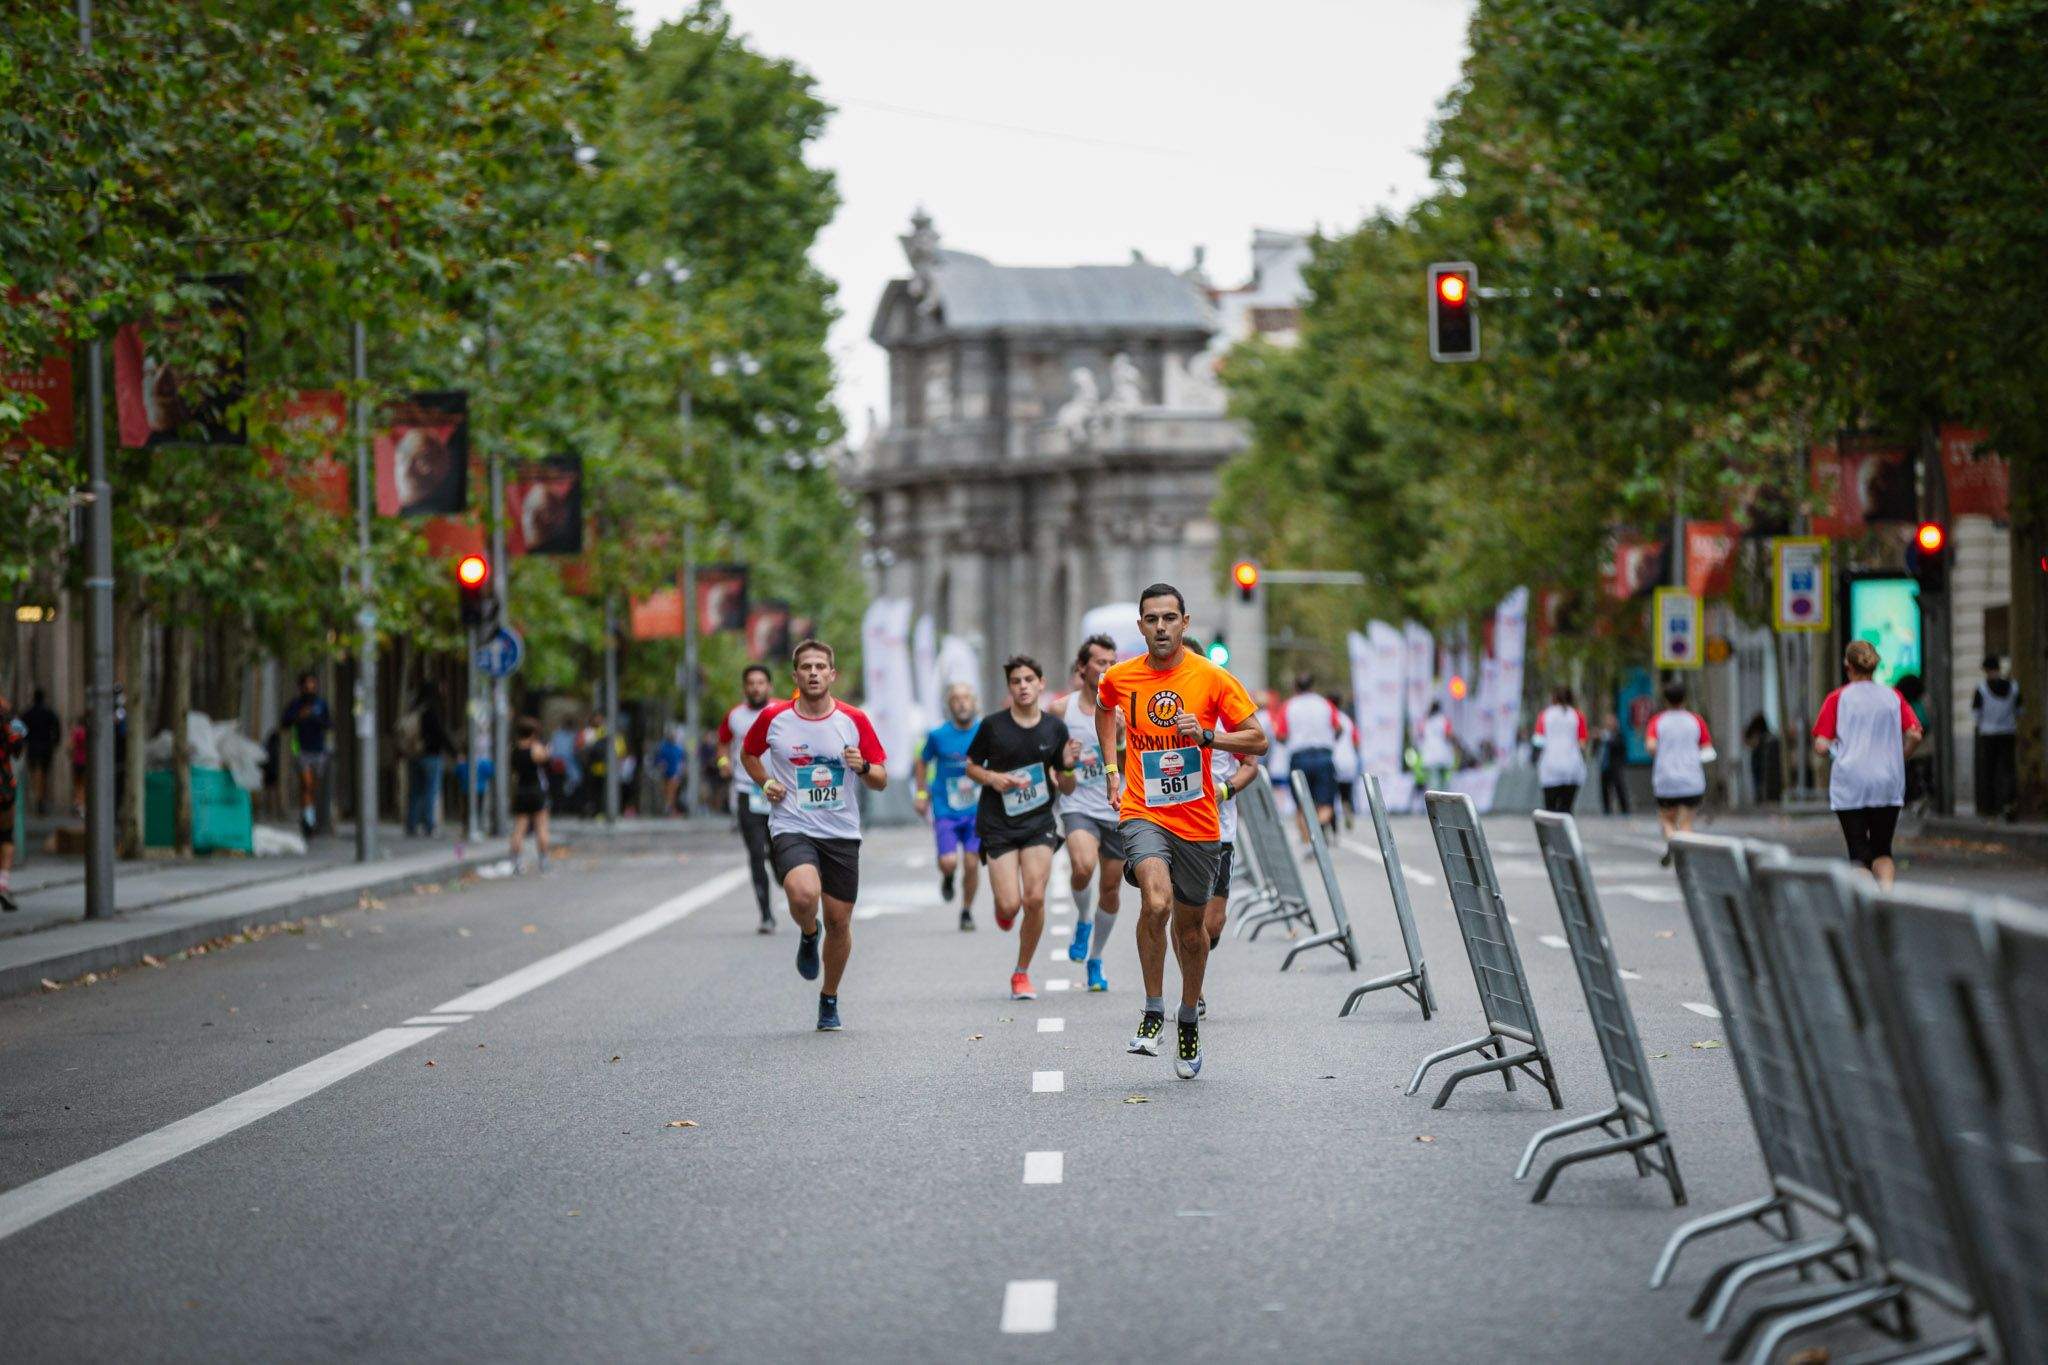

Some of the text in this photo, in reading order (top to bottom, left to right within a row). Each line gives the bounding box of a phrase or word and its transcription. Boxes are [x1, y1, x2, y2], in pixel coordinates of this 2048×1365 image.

[1148, 709, 1181, 727] RUNNER
[1131, 734, 1192, 751] RUNNING
[1160, 775, 1189, 795] 561
[808, 787, 838, 802] 1029
